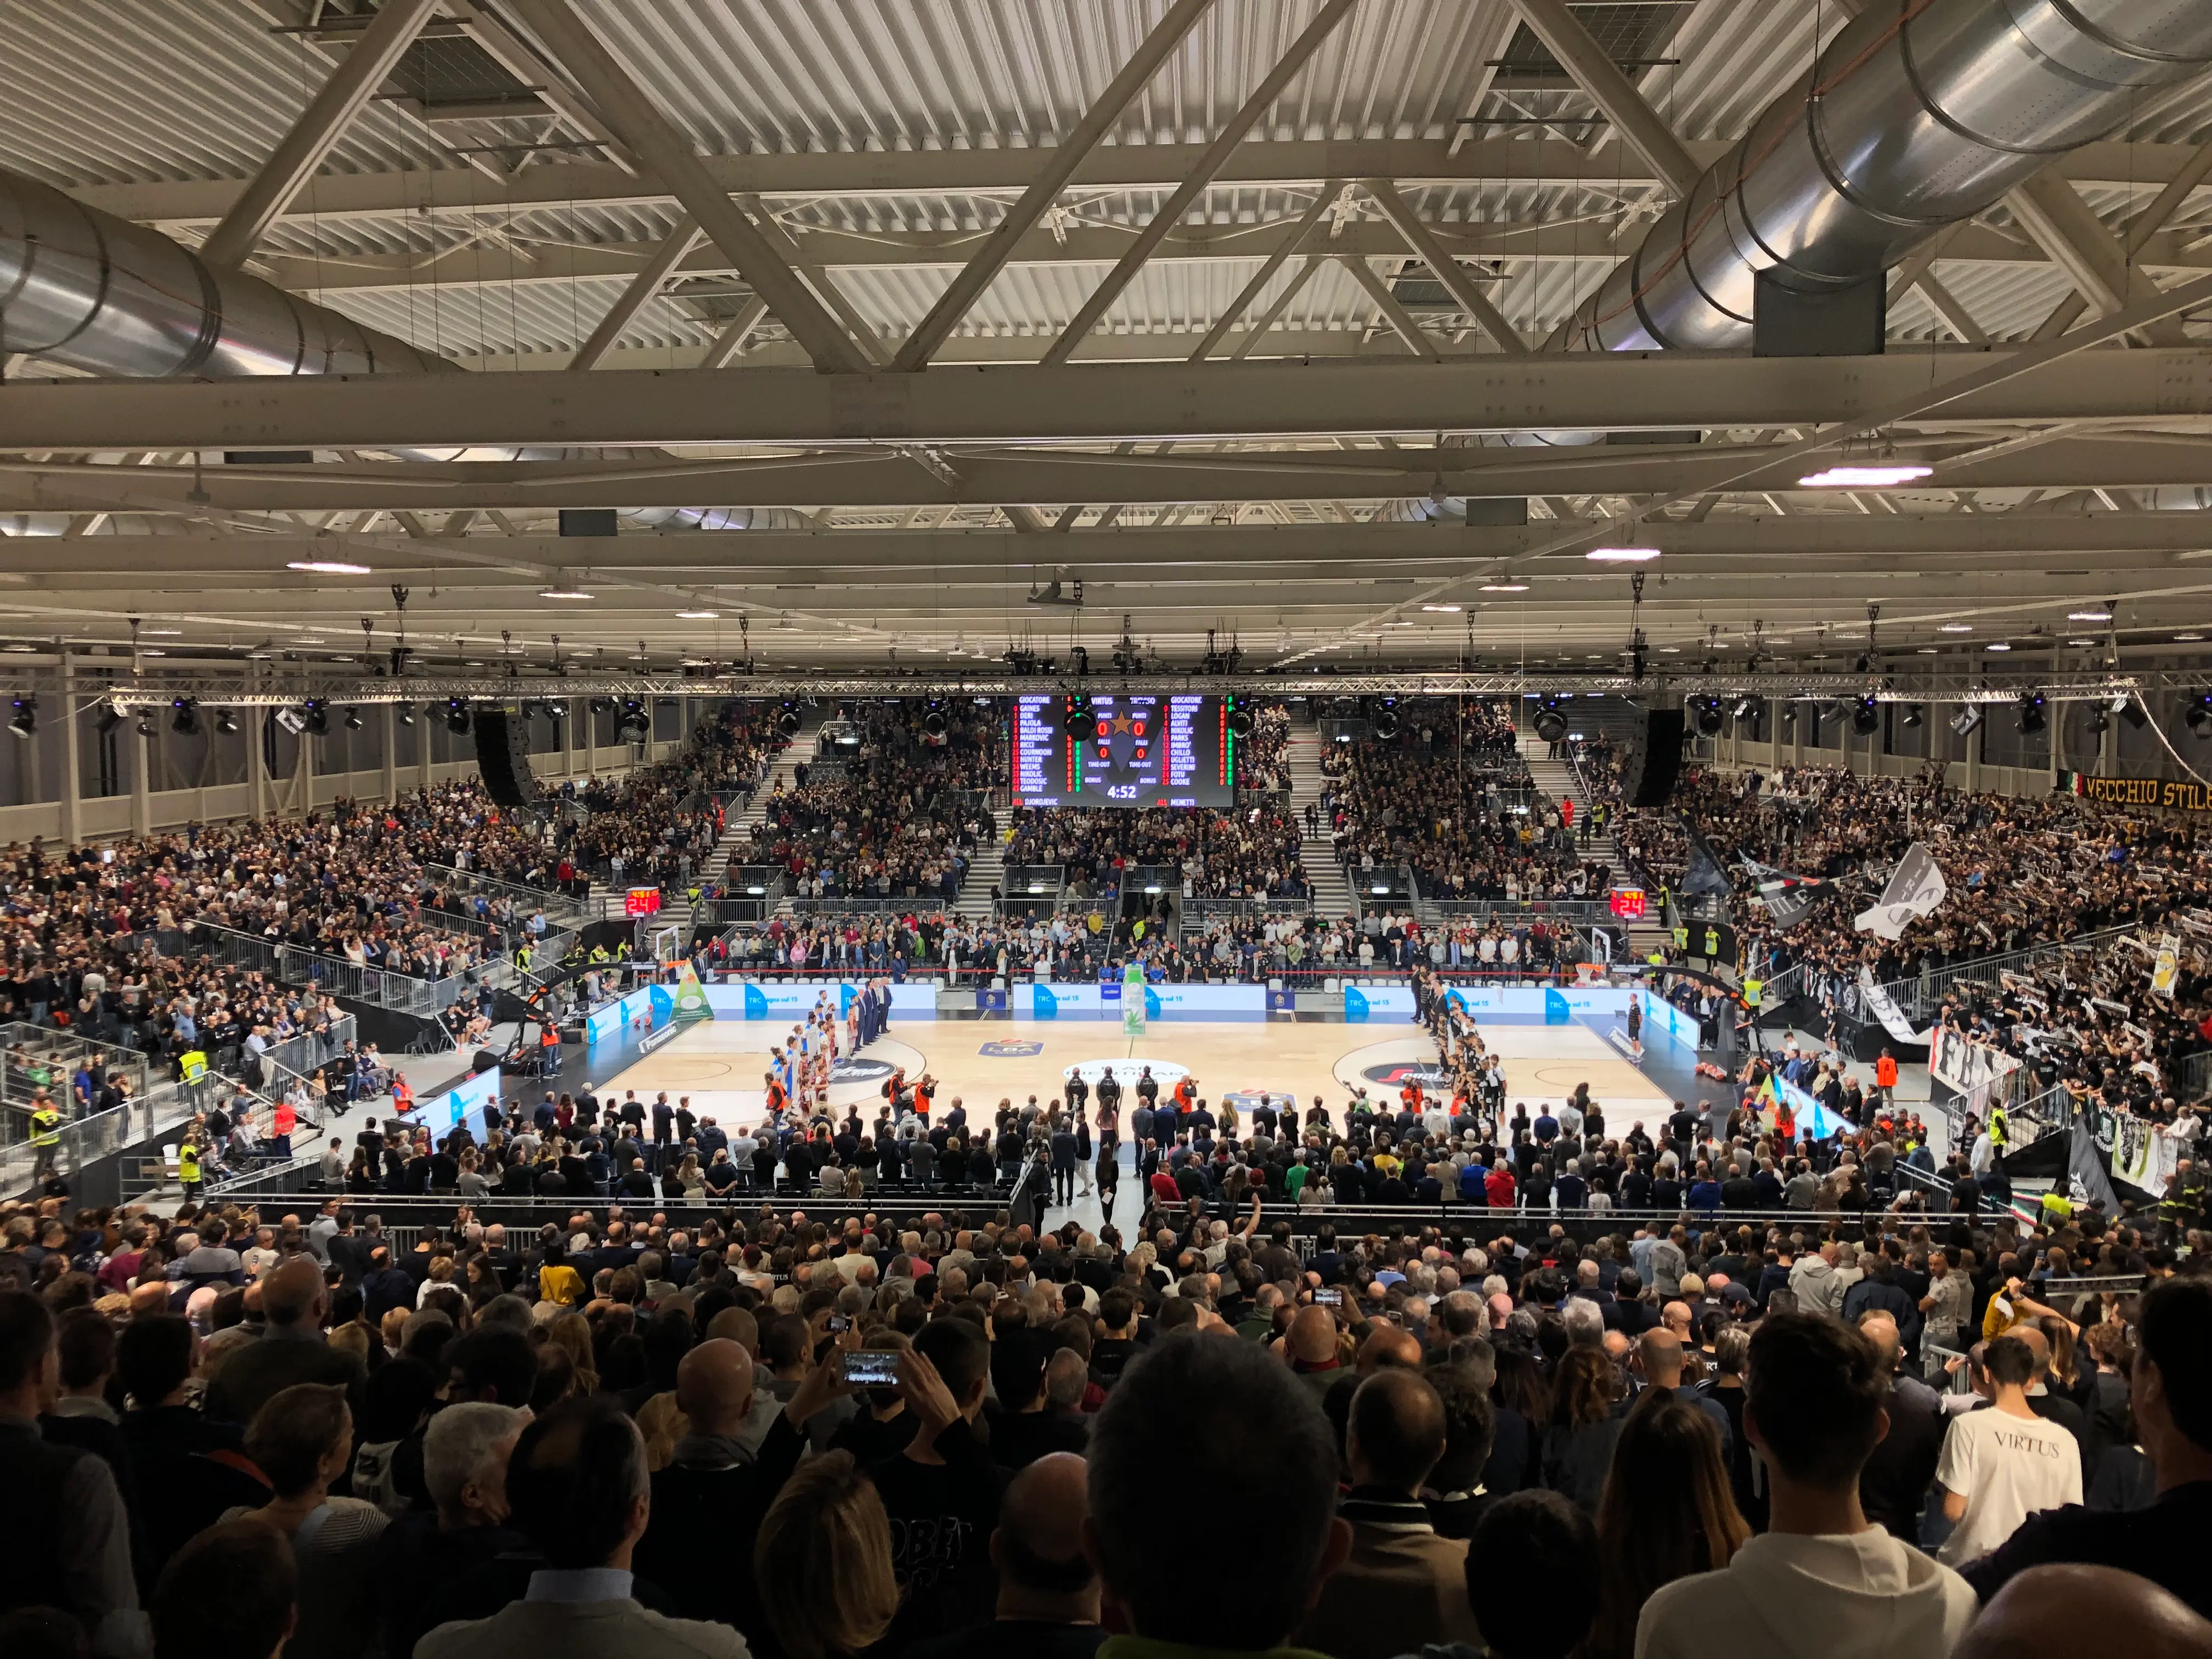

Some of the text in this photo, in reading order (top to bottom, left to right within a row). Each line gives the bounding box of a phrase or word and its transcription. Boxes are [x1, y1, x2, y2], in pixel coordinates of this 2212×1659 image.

[1091, 697, 1113, 705] VIRTUS
[1097, 722, 1108, 736] 0
[1133, 722, 1144, 736] 0
[1100, 747, 1108, 758] 0
[1137, 748, 1145, 759] 0
[1107, 786, 1136, 798] 4:52
[2087, 778, 2157, 803] VECCHIO
[1025, 798, 1058, 806] DJORDJEVIC
[628, 899, 648, 912] 24
[1620, 900, 1642, 915] 24
[646, 1024, 678, 1050] Panasonic
[1995, 1431, 2059, 1459] VIRTUS
